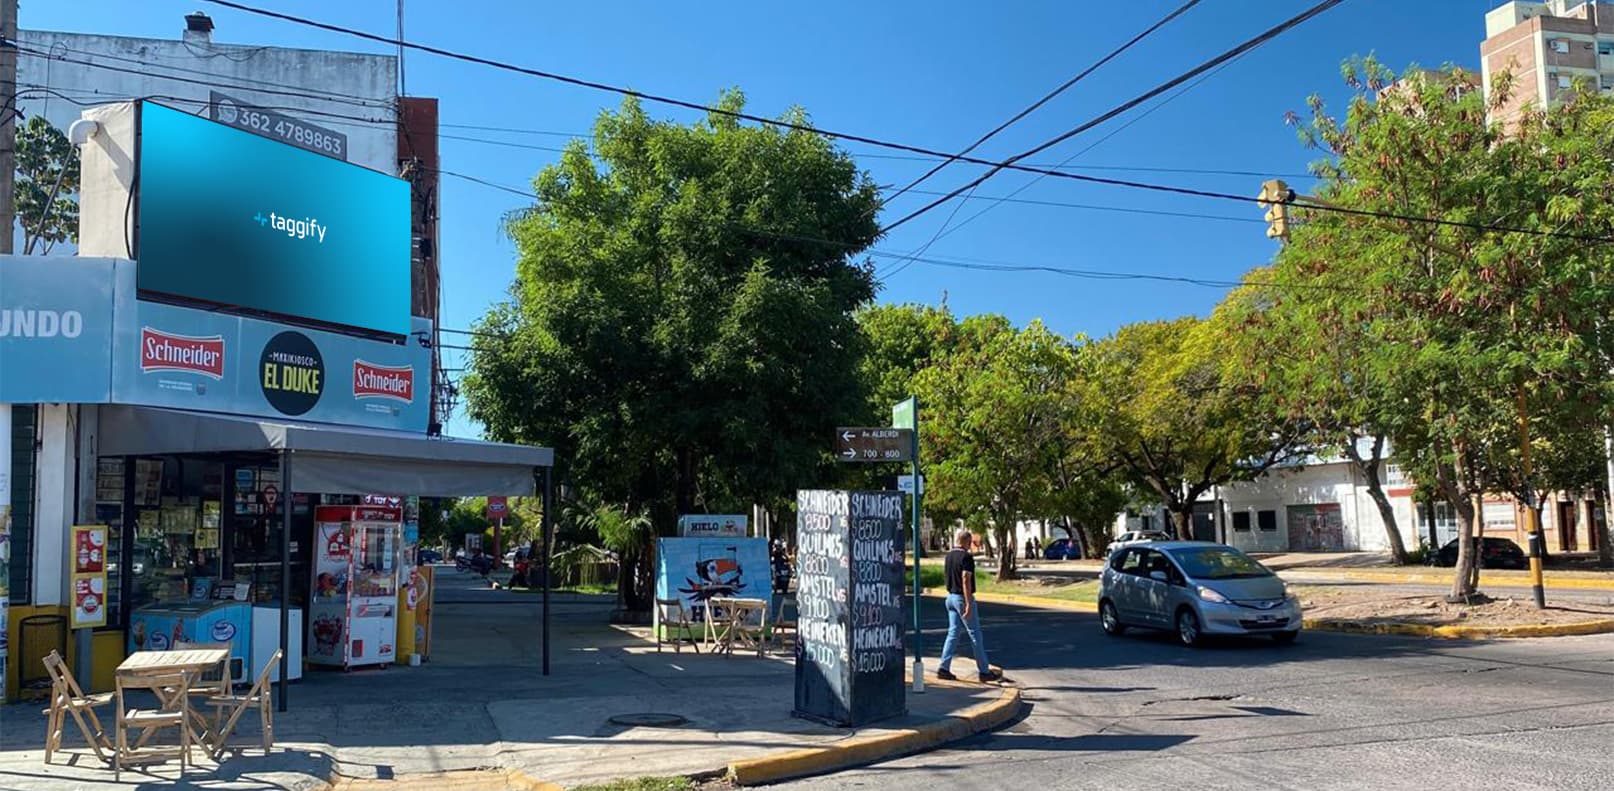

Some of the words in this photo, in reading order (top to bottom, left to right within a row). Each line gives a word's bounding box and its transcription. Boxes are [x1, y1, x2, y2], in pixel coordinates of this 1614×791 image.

[240, 108, 270, 132] 362
[275, 120, 341, 154] 4789863
[270, 212, 326, 243] taggify
[145, 338, 220, 369] Schneider
[264, 363, 279, 389] EL
[283, 365, 320, 394] DUKE
[356, 366, 410, 393] Schneider
[871, 430, 899, 438] ALBERDI
[863, 448, 878, 458] 700
[691, 522, 719, 532] HIELO
[799, 573, 836, 602] AMSTEL
[854, 582, 891, 607] AMSTEL
